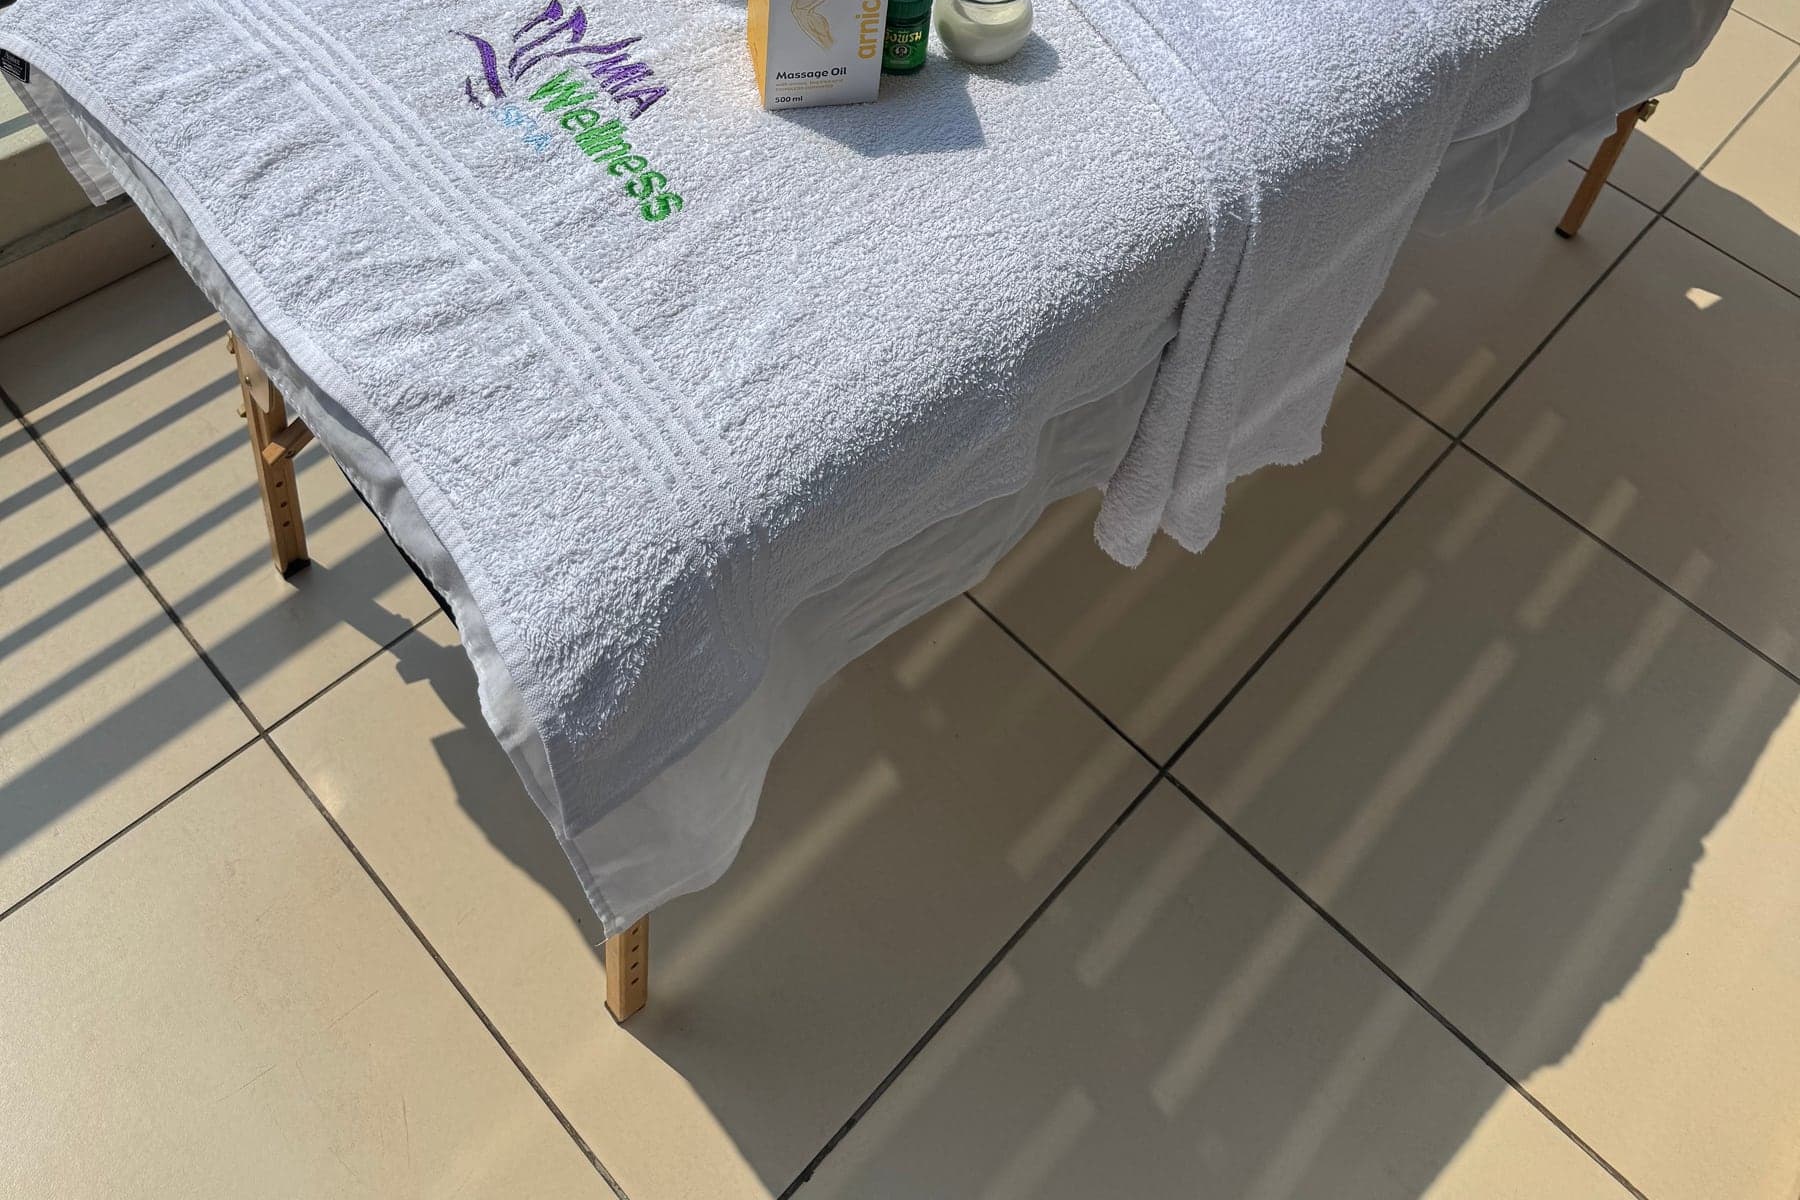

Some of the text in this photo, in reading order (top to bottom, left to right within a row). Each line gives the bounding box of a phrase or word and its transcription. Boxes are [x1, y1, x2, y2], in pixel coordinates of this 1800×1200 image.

[584, 53, 669, 120] MIA
[776, 66, 847, 80] Massage Oil
[528, 68, 684, 223] Wellness
